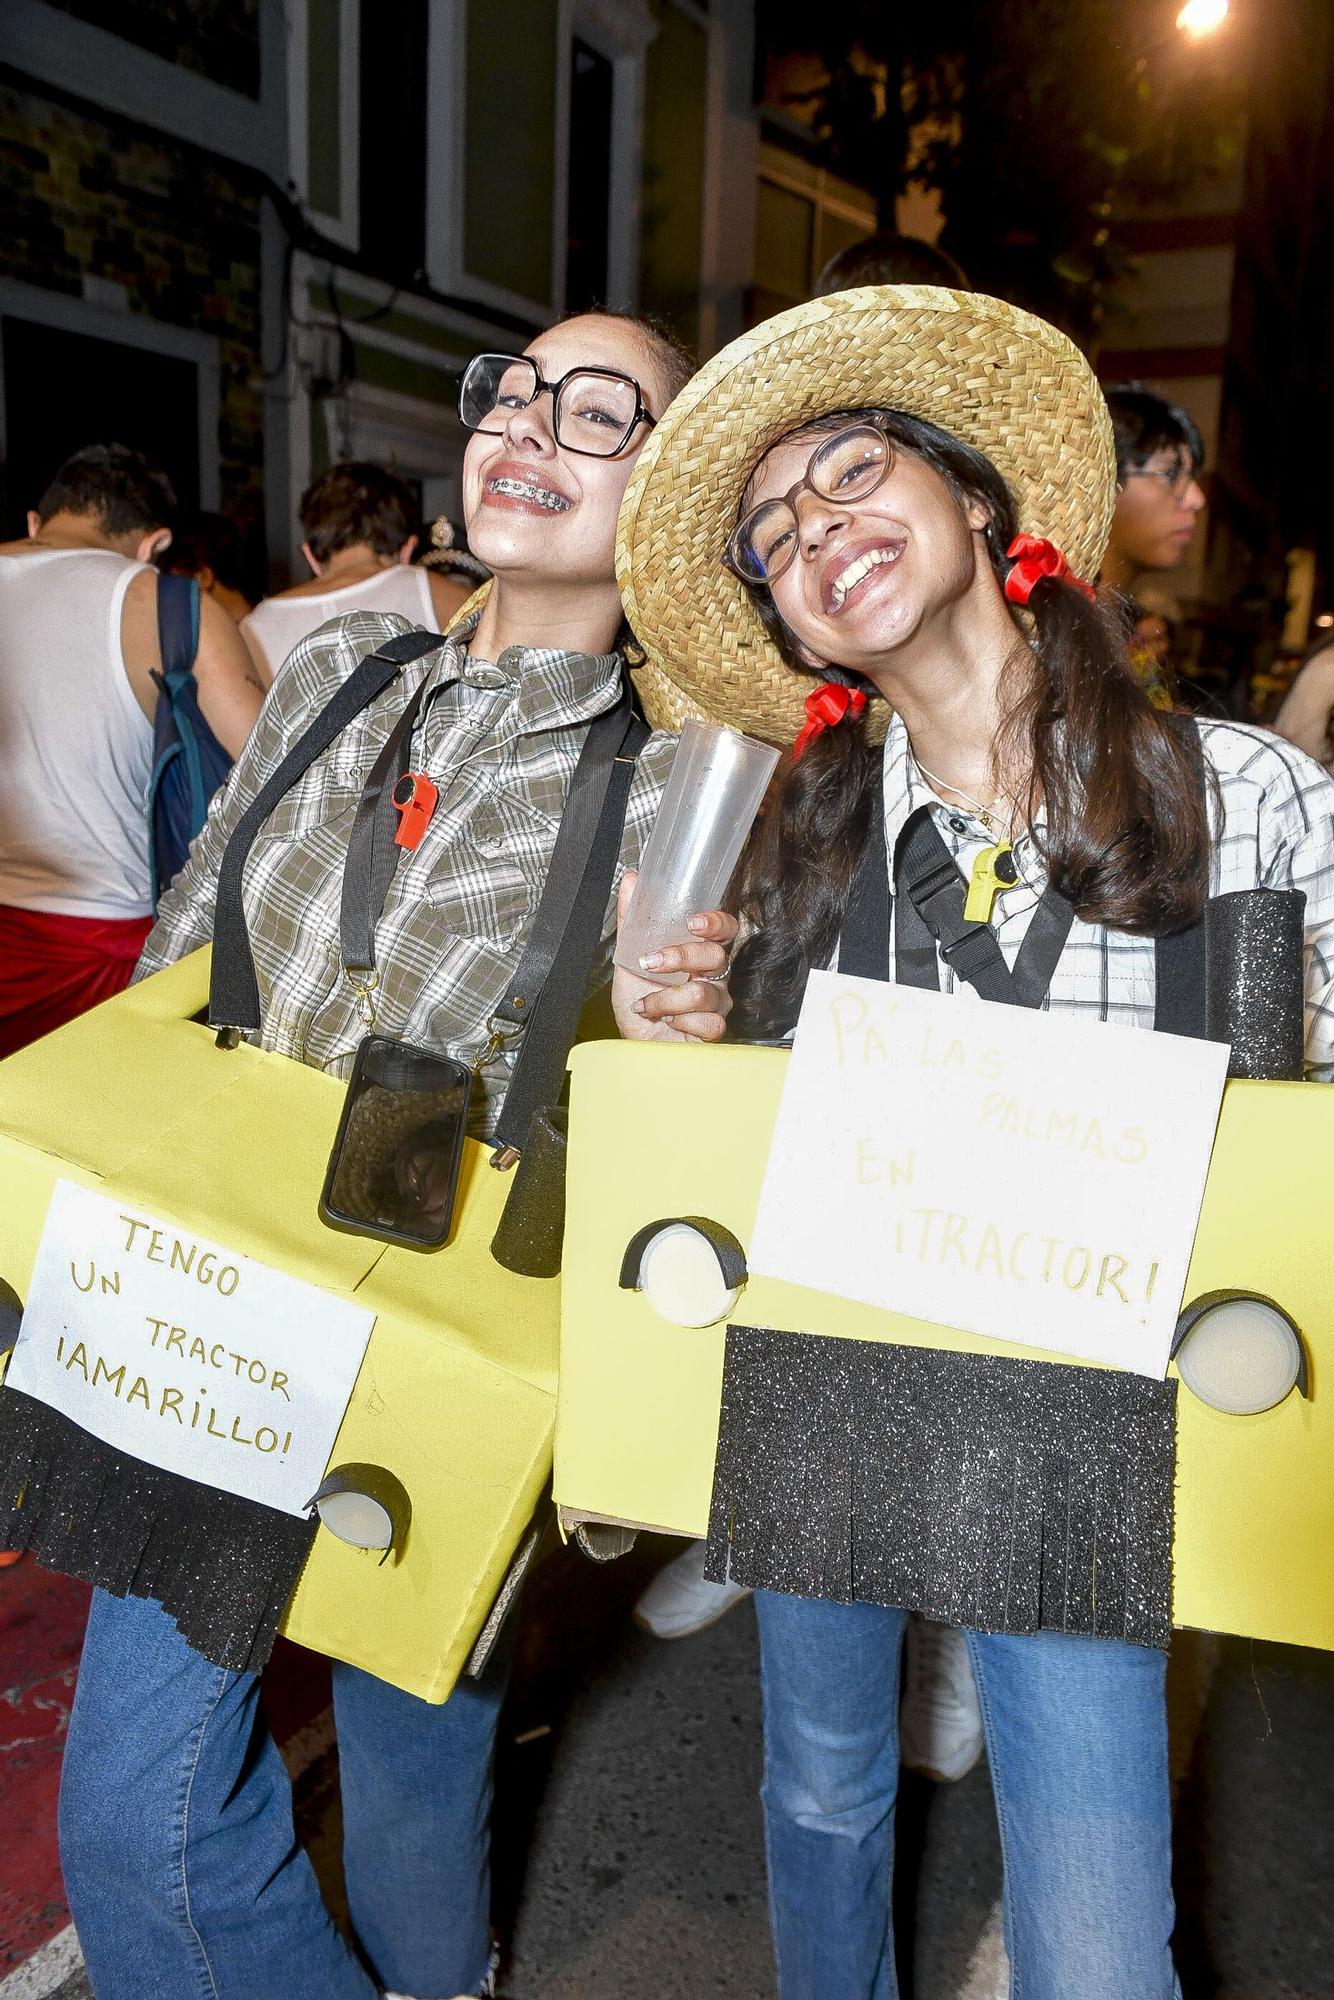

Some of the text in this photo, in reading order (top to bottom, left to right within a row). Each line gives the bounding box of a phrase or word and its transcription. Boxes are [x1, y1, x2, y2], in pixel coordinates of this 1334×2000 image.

[920, 1023, 1005, 1080] LAS
[978, 1089, 1149, 1164] PALMAS
[856, 1136, 916, 1186] EN
[70, 1261, 121, 1295] UN
[119, 1214, 241, 1297] TENGO
[145, 1316, 291, 1402] TRACTOR
